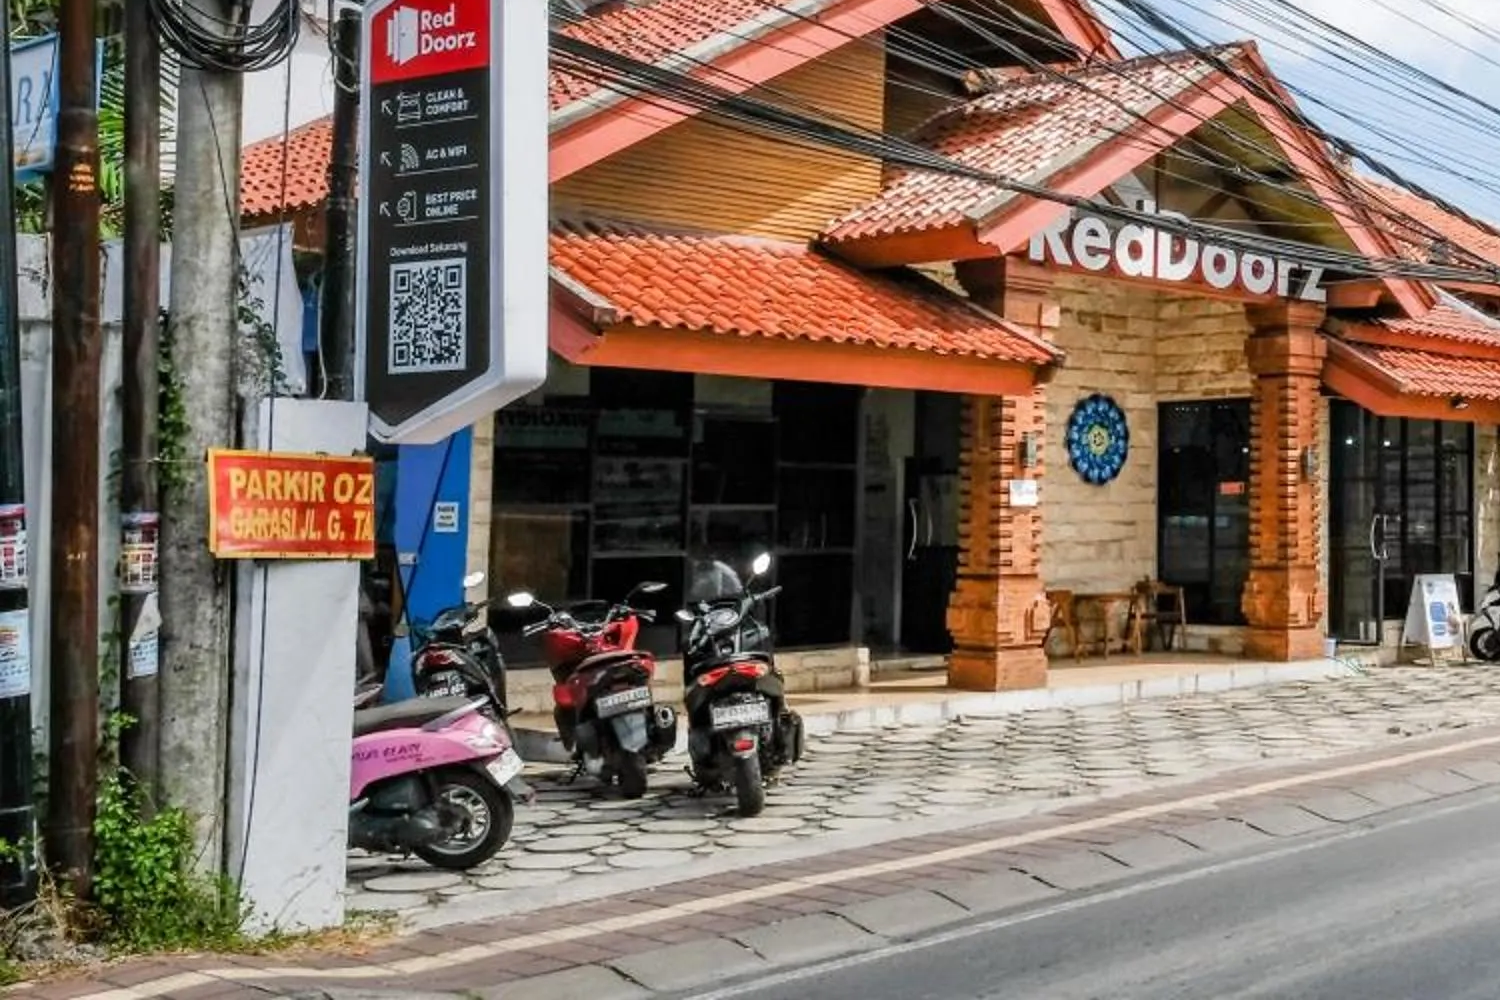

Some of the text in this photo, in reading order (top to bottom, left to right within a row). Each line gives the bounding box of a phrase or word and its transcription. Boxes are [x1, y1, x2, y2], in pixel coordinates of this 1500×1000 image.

[421, 2, 455, 31] Red
[421, 31, 477, 55] Doorz
[425, 90, 455, 103] CLEAN
[425, 100, 469, 115] COMFORT
[425, 189, 477, 204] BEST PRICE
[425, 203, 459, 217] ONLINE
[229, 467, 325, 502] PARKIR
[229, 506, 296, 540] GARASI
[328, 509, 344, 540] G.
